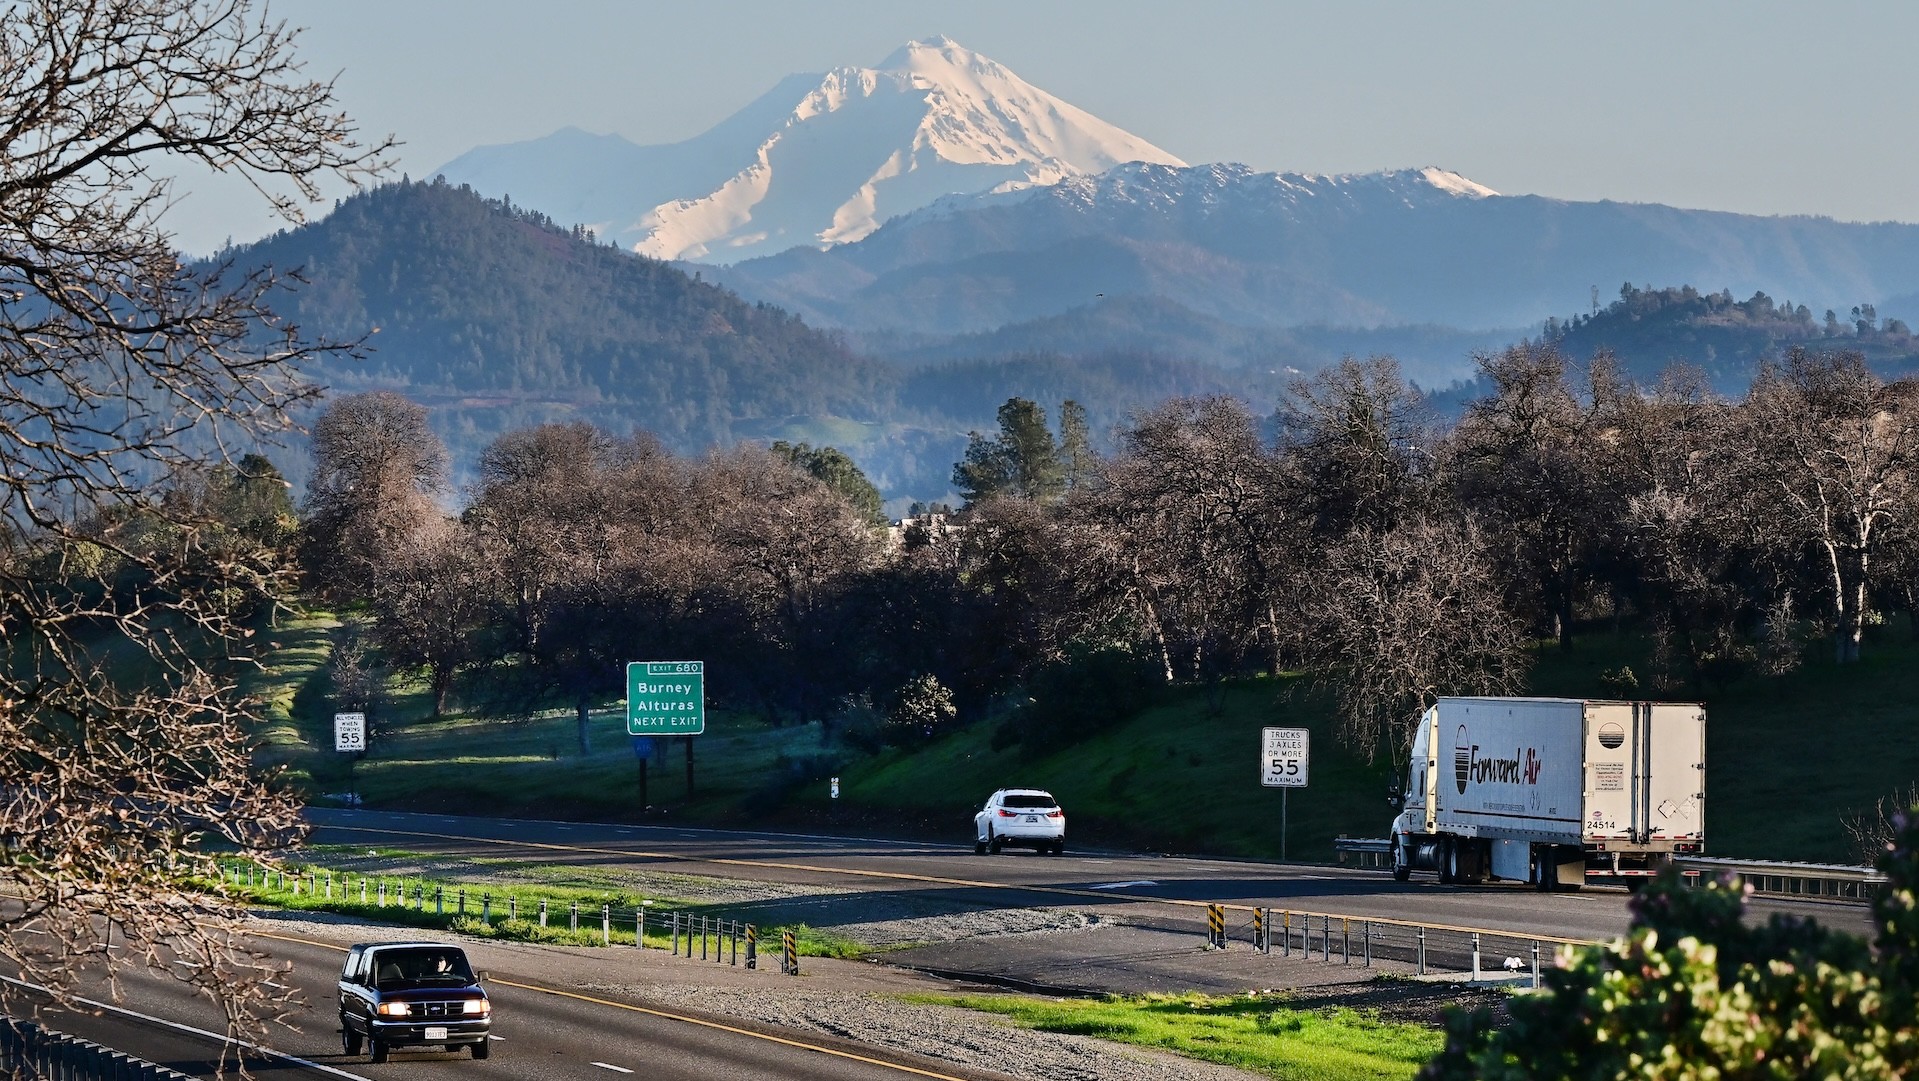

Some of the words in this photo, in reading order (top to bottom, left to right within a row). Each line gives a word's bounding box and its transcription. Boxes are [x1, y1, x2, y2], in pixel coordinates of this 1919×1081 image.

[676, 664, 698, 672] 680
[638, 682, 691, 695] Burney
[638, 701, 695, 711] Alturas
[634, 717, 665, 726] NEXT
[671, 717, 697, 726] EXIT
[342, 733, 360, 743] 55
[1276, 741, 1302, 749] AXLES
[1281, 750, 1303, 758] MORE
[1271, 759, 1299, 776] 55
[1470, 745, 1520, 784] Forward
[1522, 747, 1541, 784] Air
[1587, 821, 1615, 829] 24514
